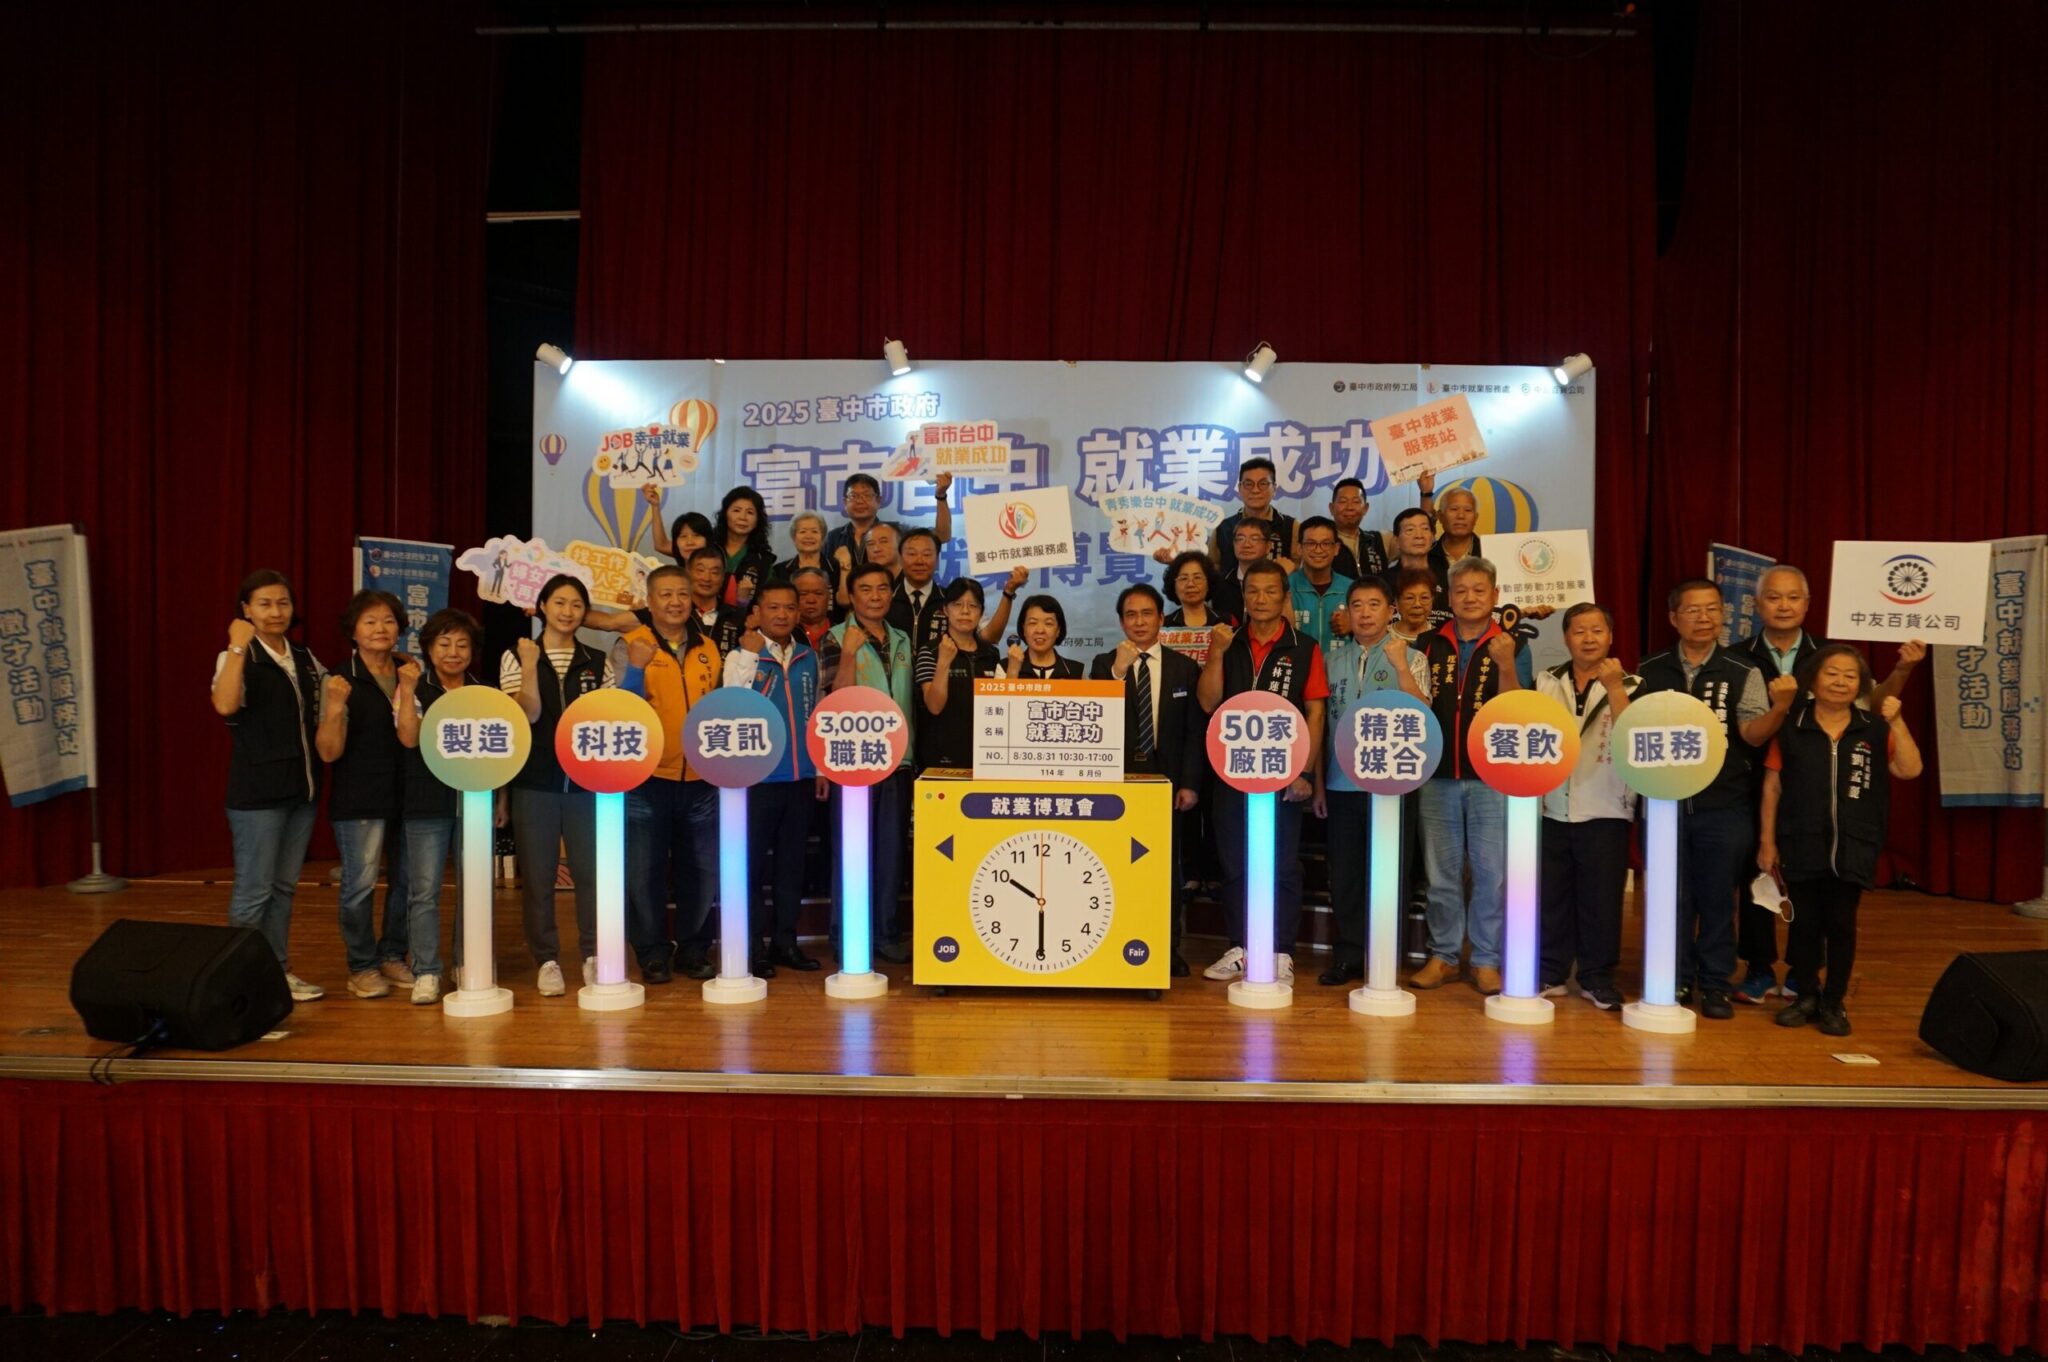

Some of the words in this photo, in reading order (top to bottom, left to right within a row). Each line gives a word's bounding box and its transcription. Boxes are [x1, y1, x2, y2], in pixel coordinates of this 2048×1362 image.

[1349, 382, 1418, 392] 臺中市政府勞工局
[1442, 383, 1511, 393] 臺中市就業服務處
[1534, 384, 1585, 394] 中百貨公司
[744, 401, 810, 427] 2025
[816, 392, 940, 424] 臺中市政府
[1387, 405, 1459, 441] 臺中就業
[924, 424, 994, 445] 富市台中
[1403, 427, 1458, 457] 服務站
[936, 445, 1007, 465] 就業成功
[1077, 421, 1390, 503] 就業成功
[1105, 496, 1167, 513] 青秀樂台中
[1169, 499, 1219, 523] 就業成功
[571, 545, 628, 571] 找工作
[974, 542, 1069, 563] 臺中市就業服務處
[593, 568, 630, 590] 人才
[1499, 580, 1586, 593] 動部勞動力發展署
[1515, 593, 1566, 605] 中彰投分署
[407, 584, 429, 654] 富市台
[1850, 611, 1960, 631] 中友百貨公司
[1064, 637, 1104, 648] 府勞工局
[1994, 570, 2025, 770] 臺中就業服務站
[980, 683, 1006, 692] 2025
[1008, 683, 1052, 692] 臺中市政府
[1957, 645, 1991, 730] 才活動
[984, 706, 1004, 716] 活動
[1027, 700, 1103, 721] 富市台中
[821, 716, 897, 736] 3,000+
[984, 727, 1004, 737] 名稱
[1026, 723, 1103, 743] 就業成功
[1224, 713, 1293, 741] 50家
[1360, 712, 1421, 742] 精準
[442, 723, 509, 754] 製造
[577, 725, 642, 756] 科技
[703, 722, 767, 753] 資訊
[1490, 727, 1558, 759] 餐飲
[1634, 729, 1702, 763] 服務
[829, 739, 888, 766] 職缺
[986, 752, 1004, 760] NO.
[1013, 752, 1056, 762] 8/30.8/31
[1059, 752, 1113, 762] 10:30-17:00
[1230, 746, 1287, 775] 廠商
[1360, 746, 1421, 775] 媒合
[1057, 769, 1065, 777] 年
[1078, 769, 1084, 777] 8
[1086, 769, 1102, 778] 月份
[991, 796, 1095, 817] 就業博覽會
[1010, 851, 1025, 863] 11
[1033, 844, 1050, 857] 12
[1065, 852, 1071, 864] 1
[991, 870, 1010, 883] 10
[1082, 871, 1093, 884] 2
[984, 895, 994, 908] 9
[1089, 897, 1099, 910] 3
[991, 921, 1001, 934] 8
[1080, 923, 1091, 935] 4
[937, 944, 956, 954] JOB
[1009, 939, 1019, 951] 7
[1062, 940, 1072, 952] 5
[1129, 947, 1146, 957] Fair
